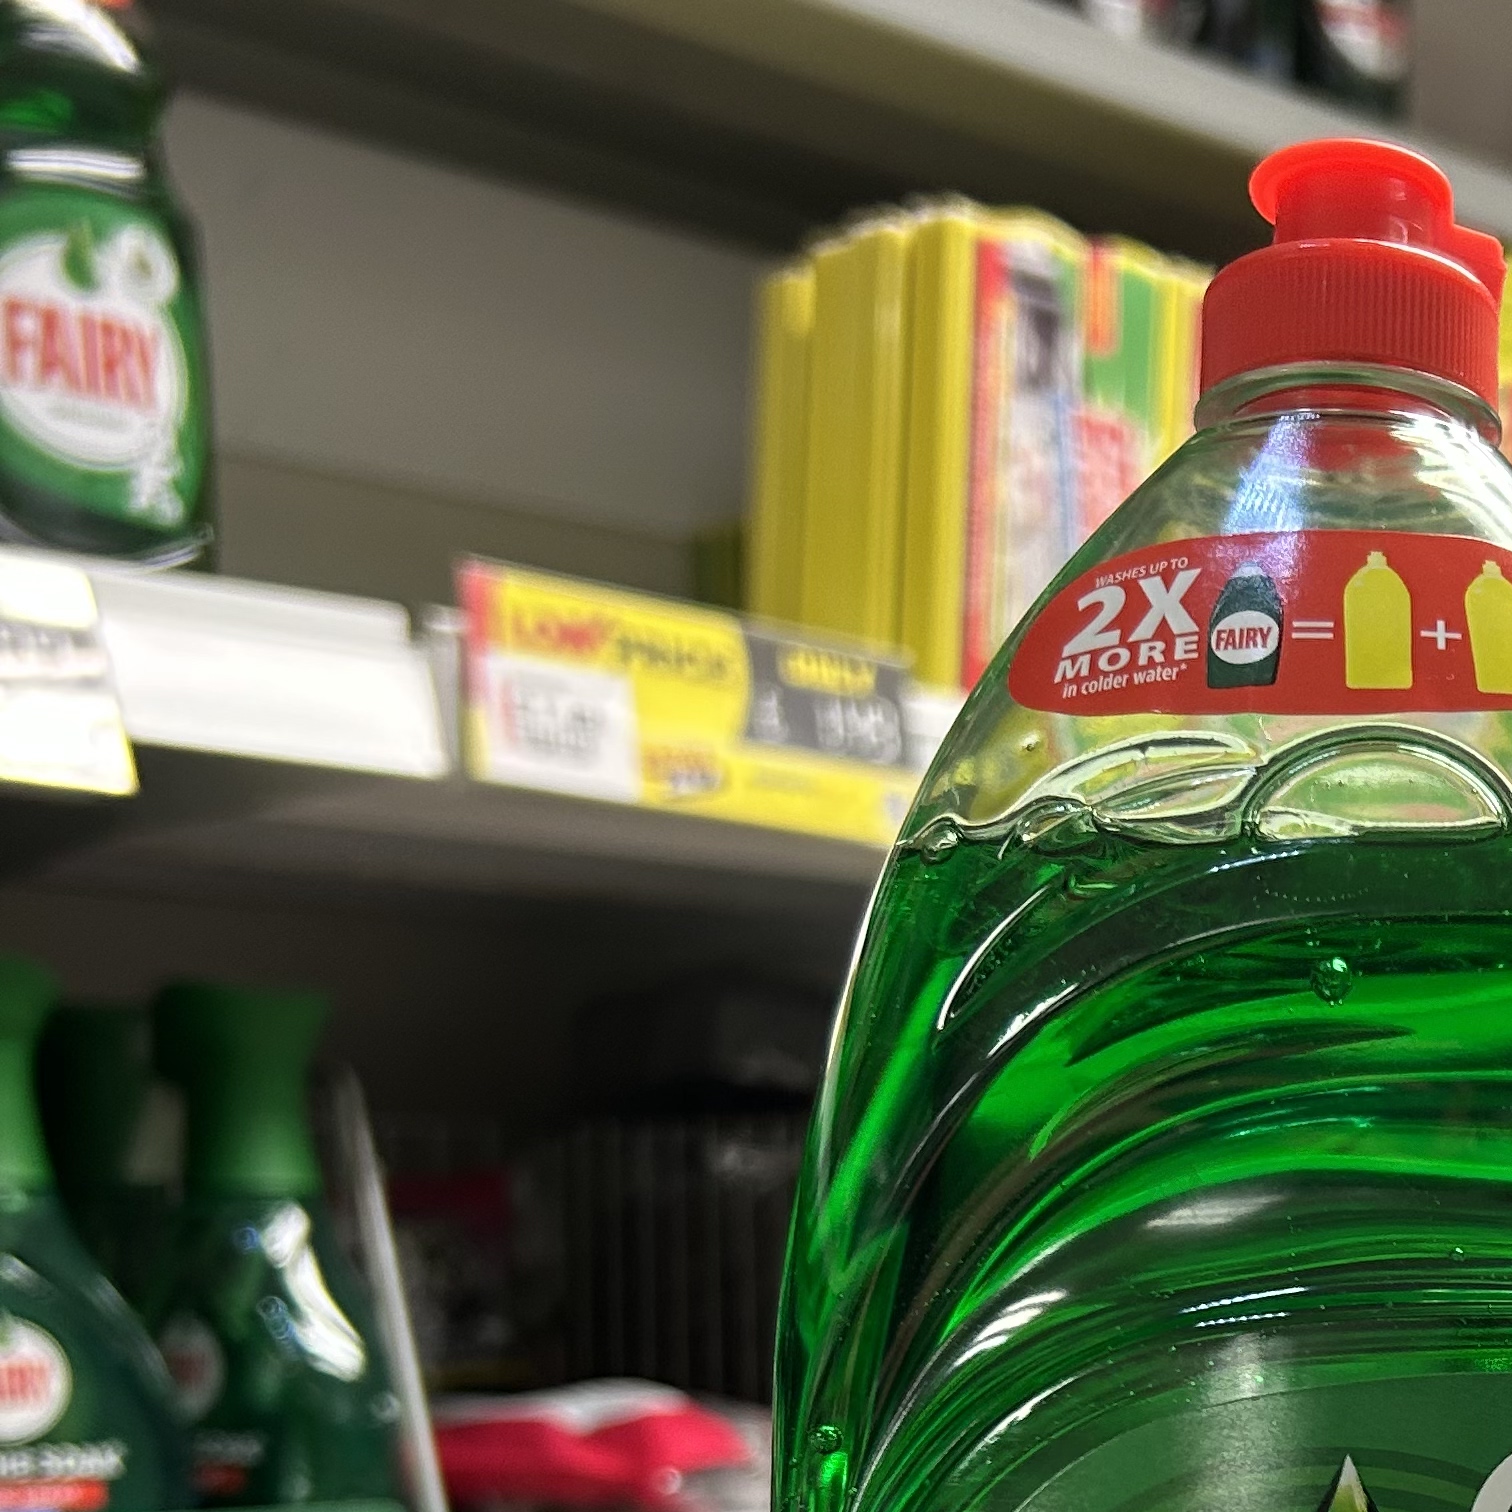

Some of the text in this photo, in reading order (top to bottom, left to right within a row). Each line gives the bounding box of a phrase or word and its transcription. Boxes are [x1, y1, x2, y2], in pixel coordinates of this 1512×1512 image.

[2, 294, 158, 412] FAIRY
[1095, 556, 1189, 588] WASHES UP TO
[1061, 567, 1202, 659] 2X
[1053, 634, 1200, 684] MORE
[1214, 626, 1273, 652] FAIRY
[1062, 682, 1078, 699] in
[1080, 672, 1129, 695] colder
